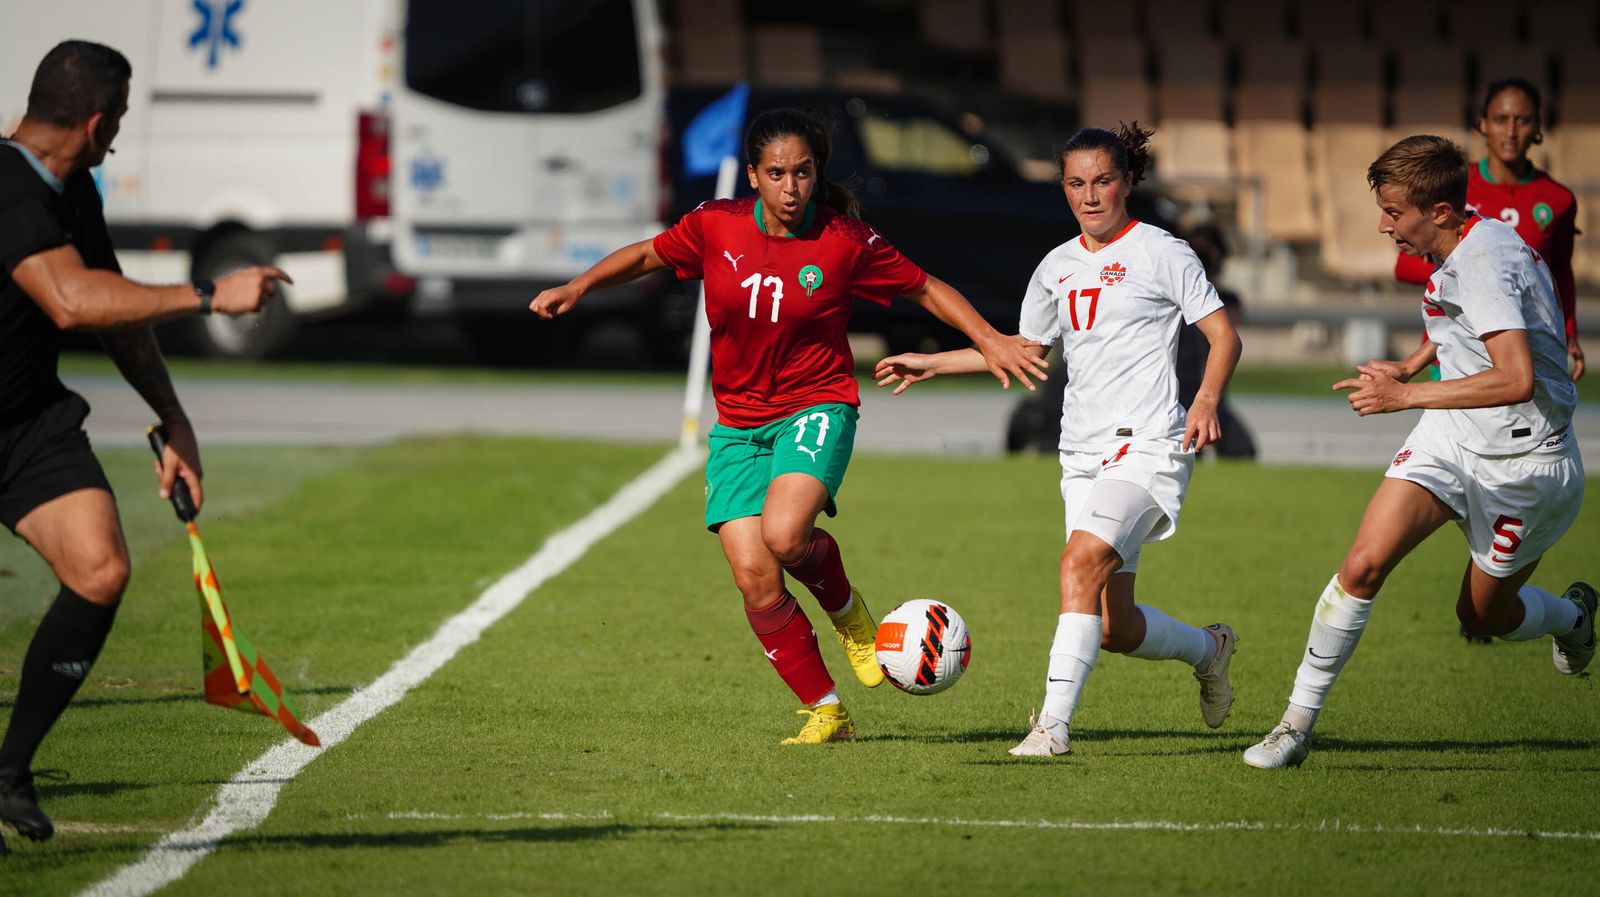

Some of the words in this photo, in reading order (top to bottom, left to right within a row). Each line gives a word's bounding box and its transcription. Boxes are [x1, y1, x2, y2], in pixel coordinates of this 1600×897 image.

[741, 273, 784, 323] 17
[1067, 287, 1102, 331] 17
[793, 412, 830, 446] 17
[1492, 514, 1523, 554] 5
